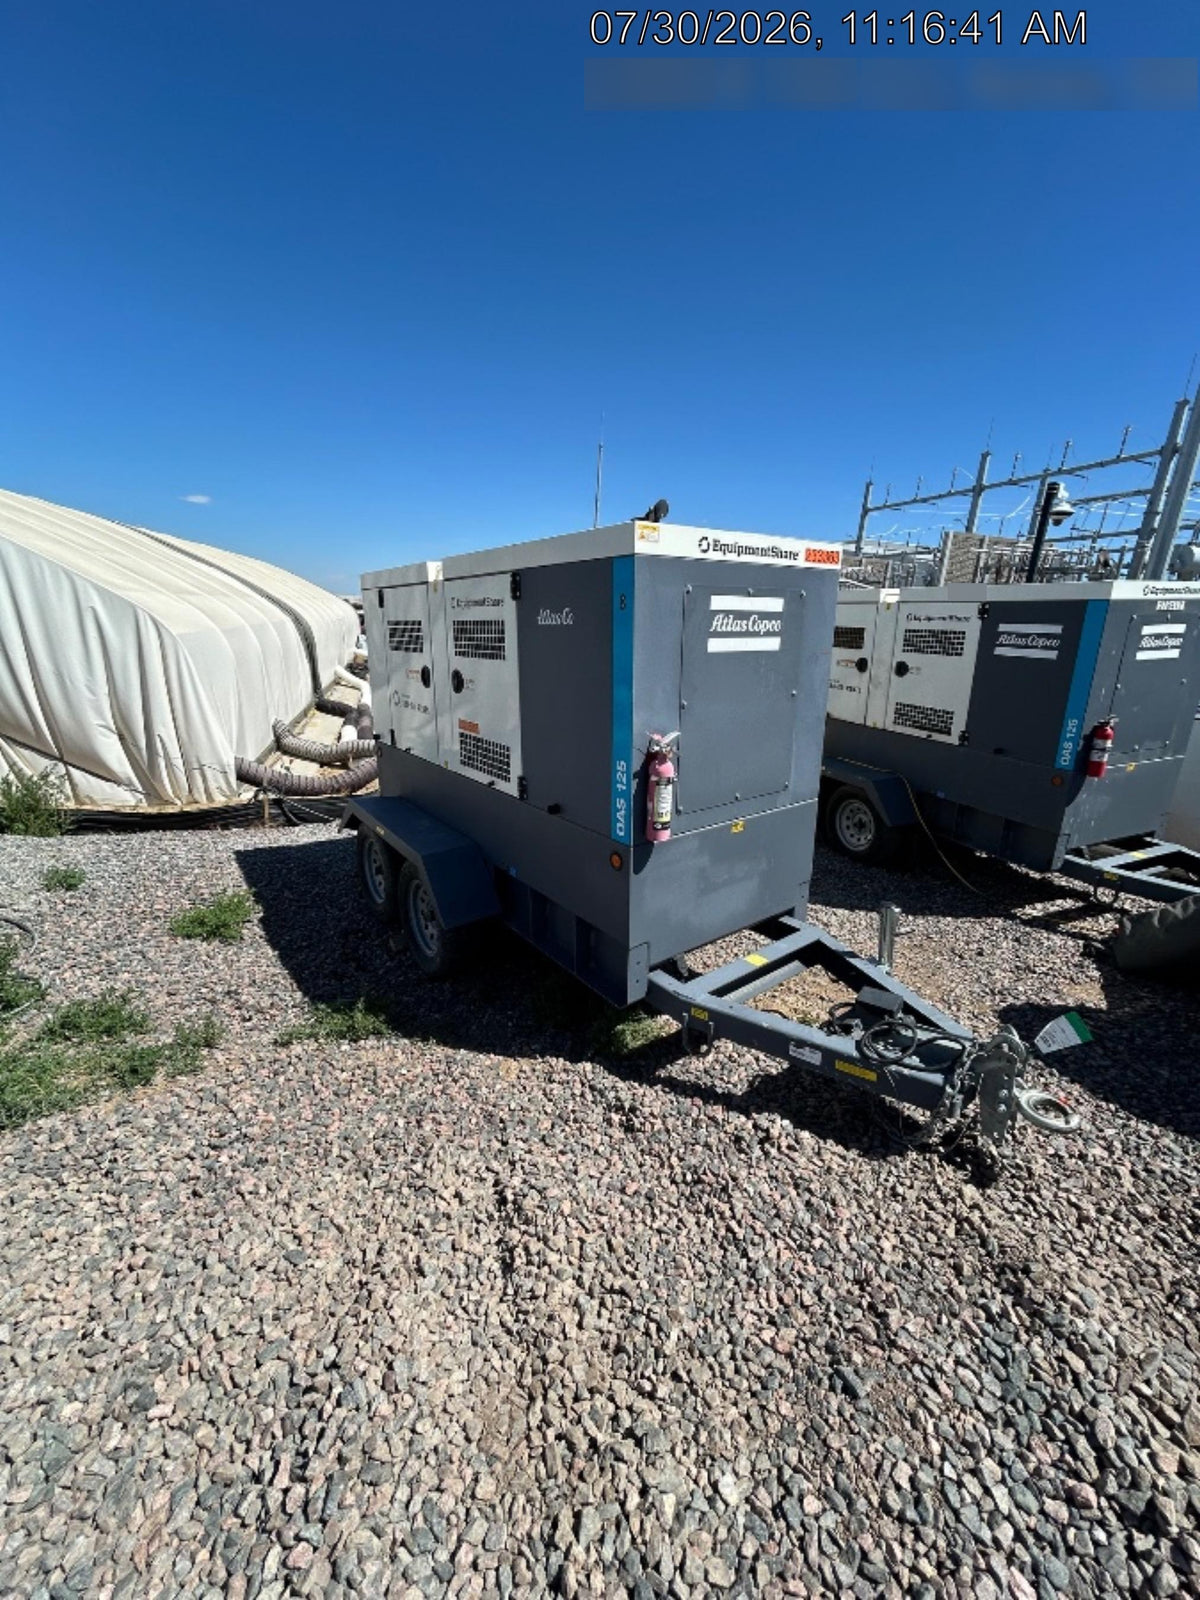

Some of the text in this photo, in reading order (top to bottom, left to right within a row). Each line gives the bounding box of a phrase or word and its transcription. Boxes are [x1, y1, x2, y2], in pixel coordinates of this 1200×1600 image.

[712, 538, 799, 561] EquipmentShare
[709, 613, 782, 636] Atlas Copco
[616, 760, 627, 792] 125
